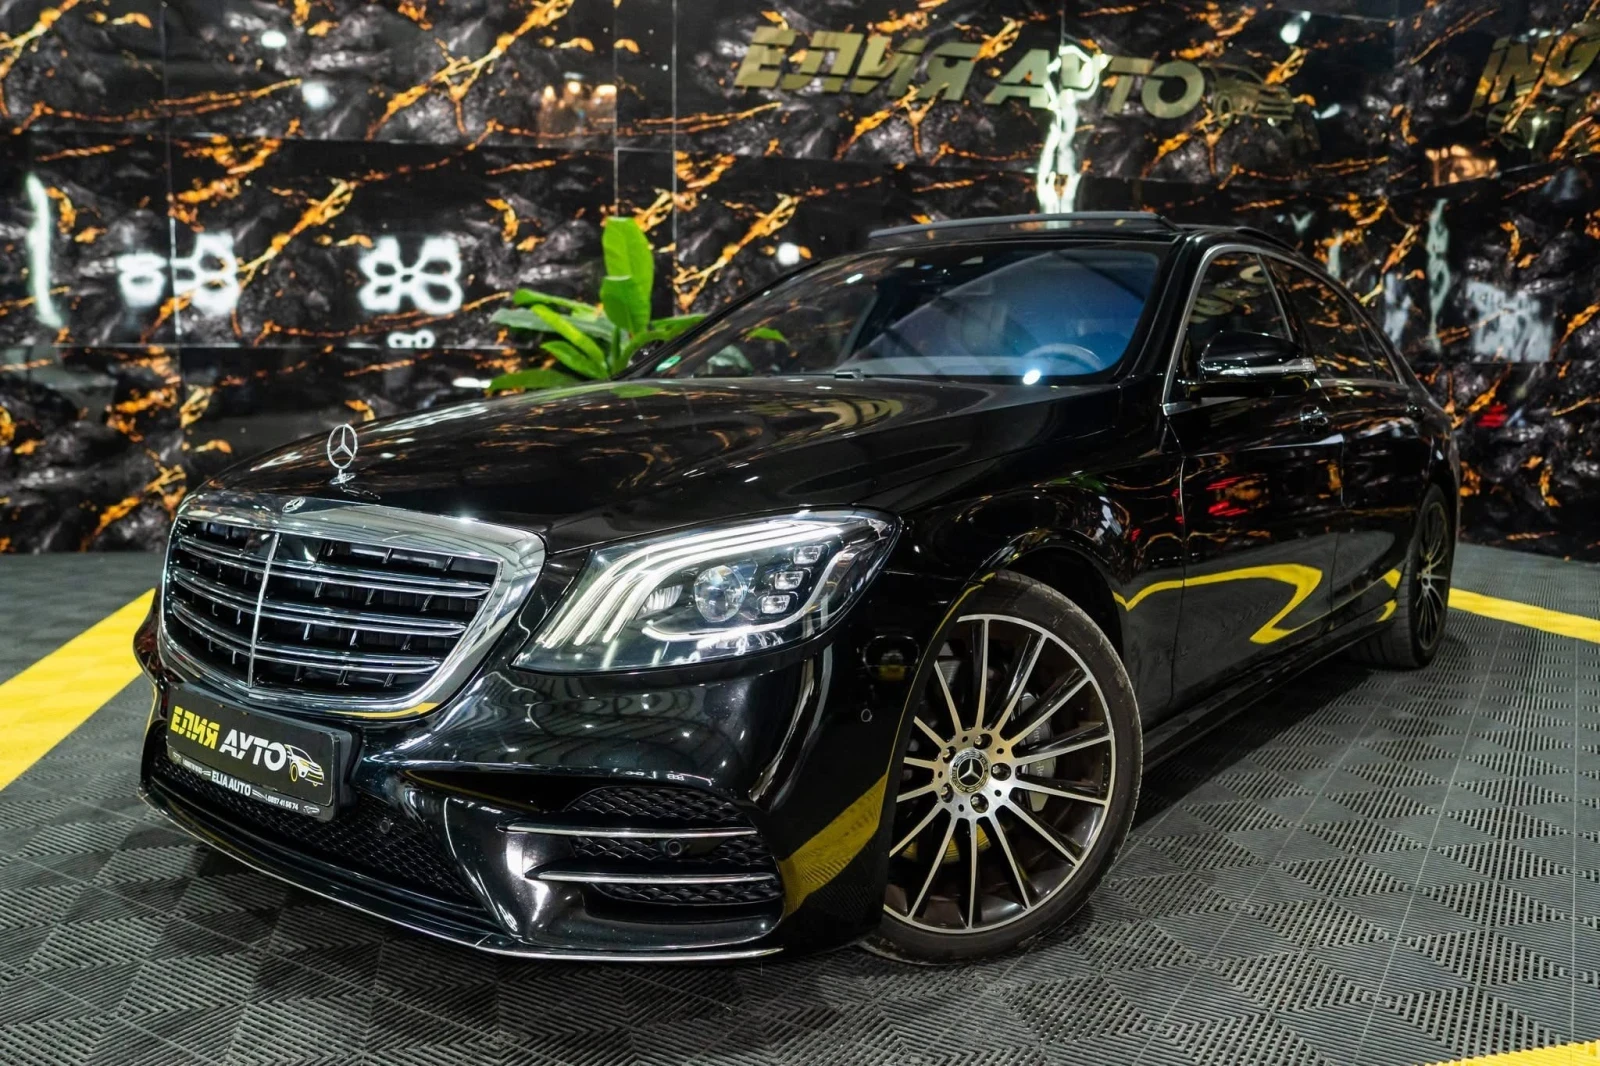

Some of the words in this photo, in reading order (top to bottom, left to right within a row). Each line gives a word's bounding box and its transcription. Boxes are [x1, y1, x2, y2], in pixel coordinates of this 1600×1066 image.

[733, 25, 982, 101] ЕЛИЯ
[984, 48, 1205, 119] АУТО
[170, 705, 221, 750] ЕЛИЯ
[218, 728, 287, 772] АУТО
[211, 769, 229, 788] ELIA
[227, 777, 252, 797] AUTO
